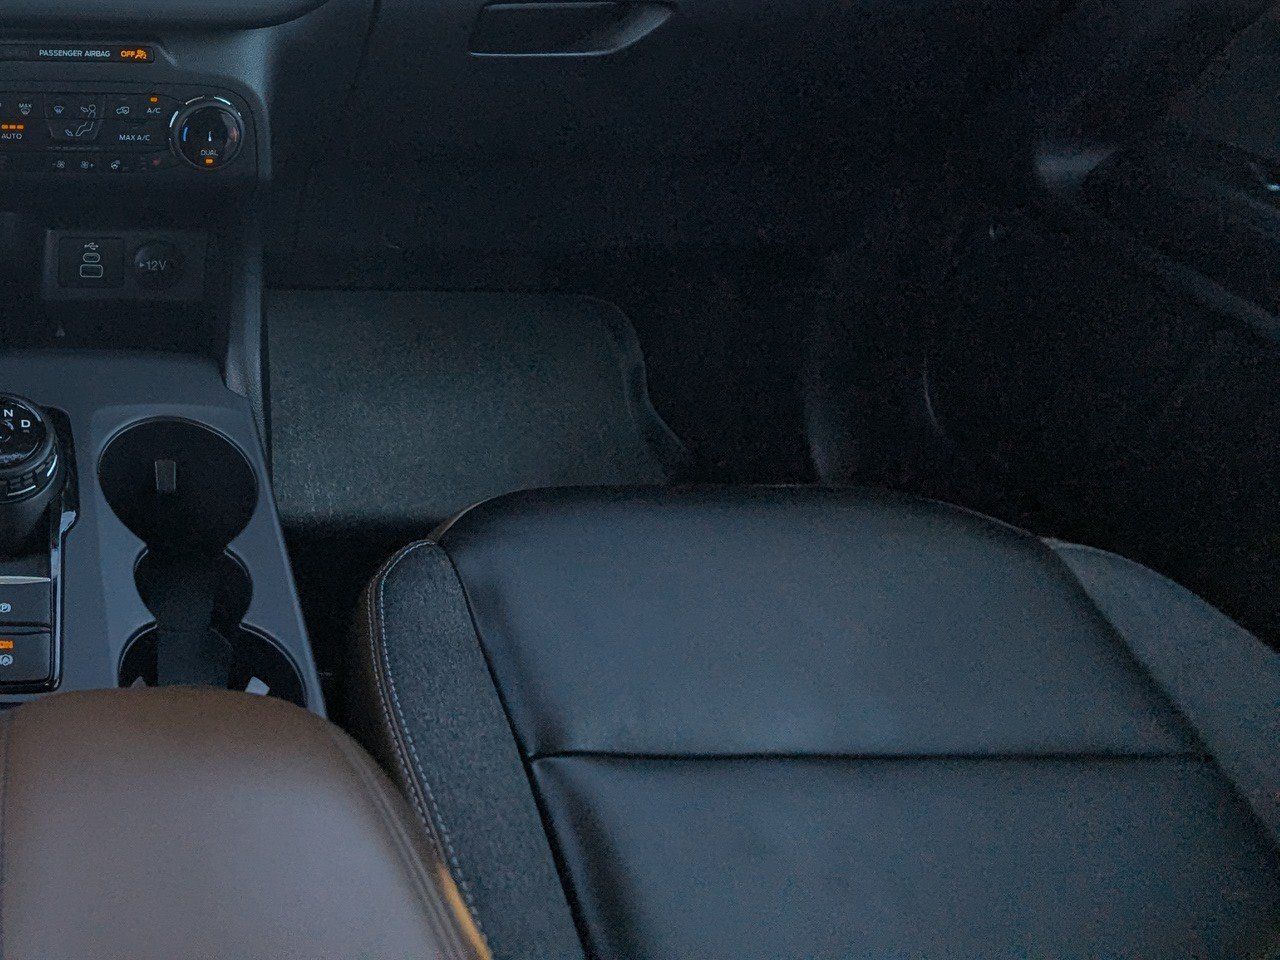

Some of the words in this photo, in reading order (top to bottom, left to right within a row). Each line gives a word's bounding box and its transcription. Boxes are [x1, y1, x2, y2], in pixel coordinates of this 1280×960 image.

[39, 49, 82, 57] PASSENGER
[84, 50, 111, 58] AIRBAG
[120, 50, 136, 58] OFF
[1, 132, 23, 140] AUTO
[146, 260, 167, 271] 12V
